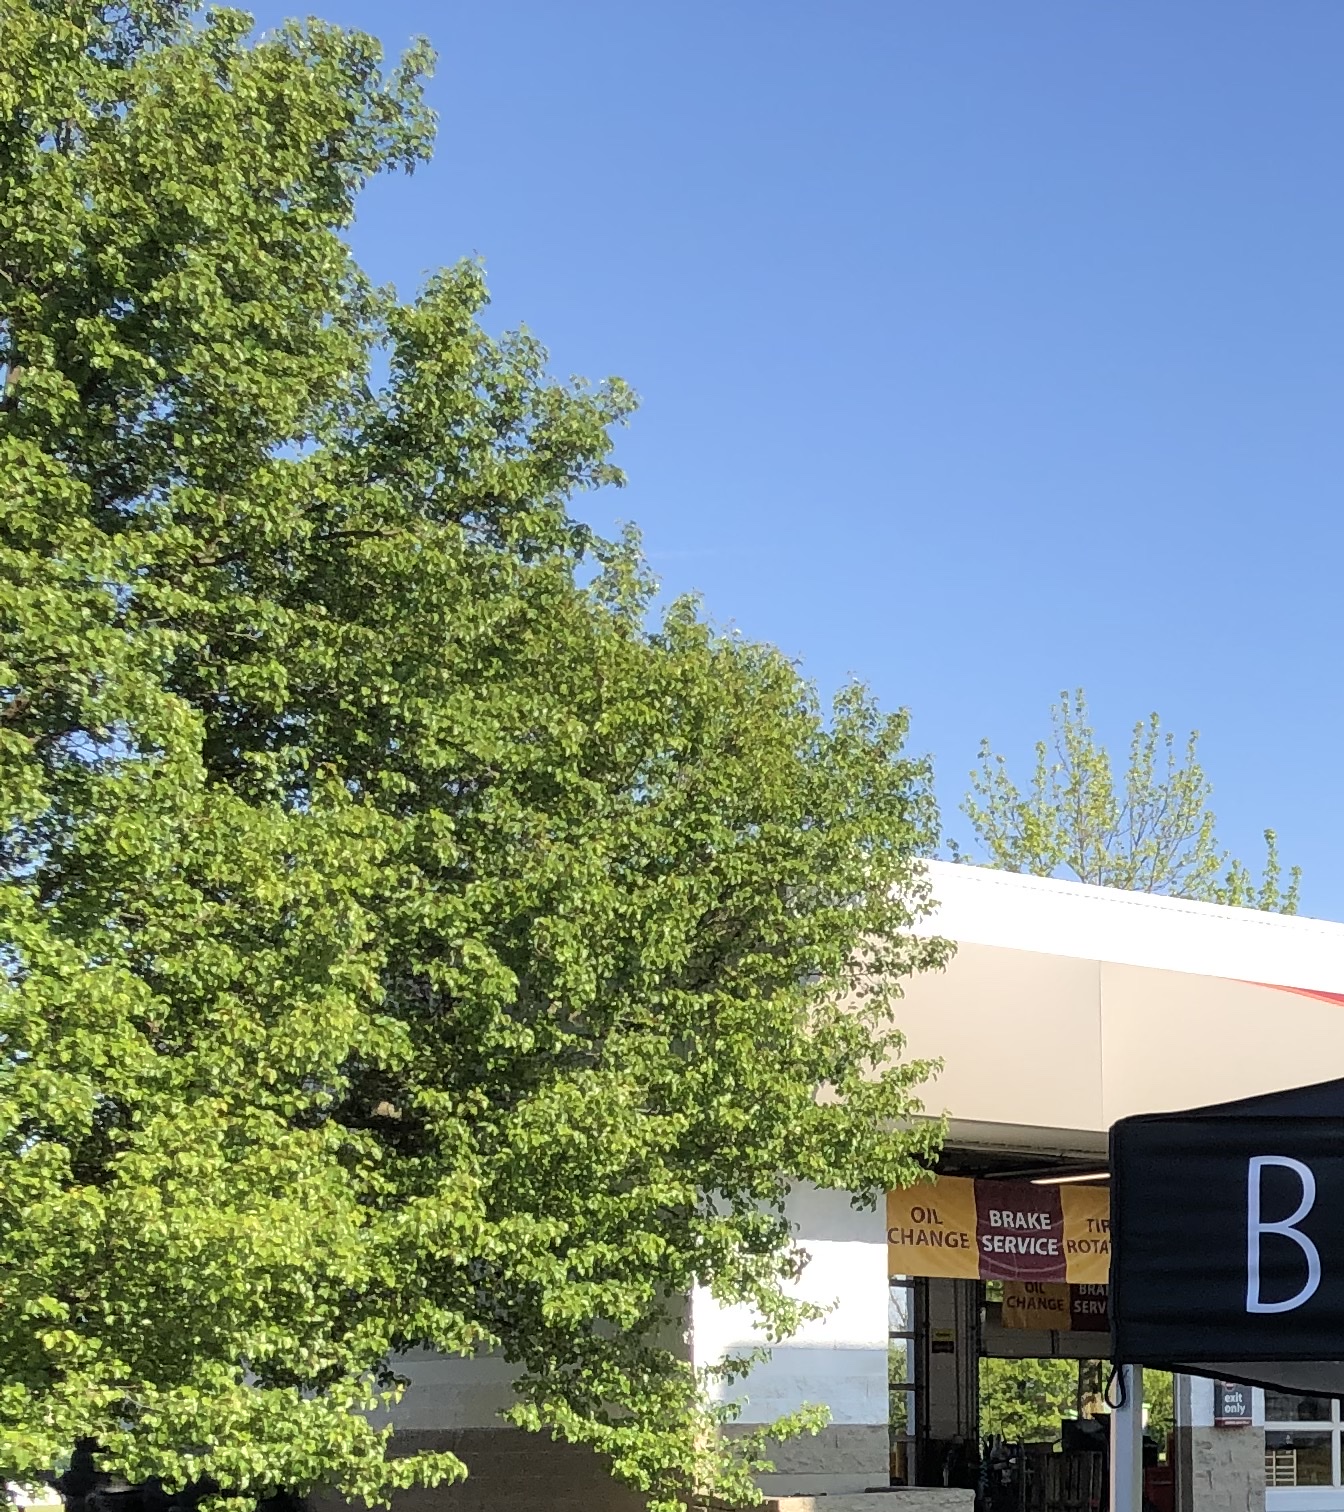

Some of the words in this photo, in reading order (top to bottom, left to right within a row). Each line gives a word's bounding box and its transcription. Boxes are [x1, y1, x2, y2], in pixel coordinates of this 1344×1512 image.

[910, 1206, 943, 1225] OIL
[989, 1209, 1051, 1230] BRAKE
[887, 1227, 970, 1249] CHANGE
[982, 1234, 1059, 1256] SERVICE
[1006, 1296, 1065, 1311] CHANGE
[1224, 1391, 1243, 1403] exit
[1224, 1402, 1246, 1416] only
